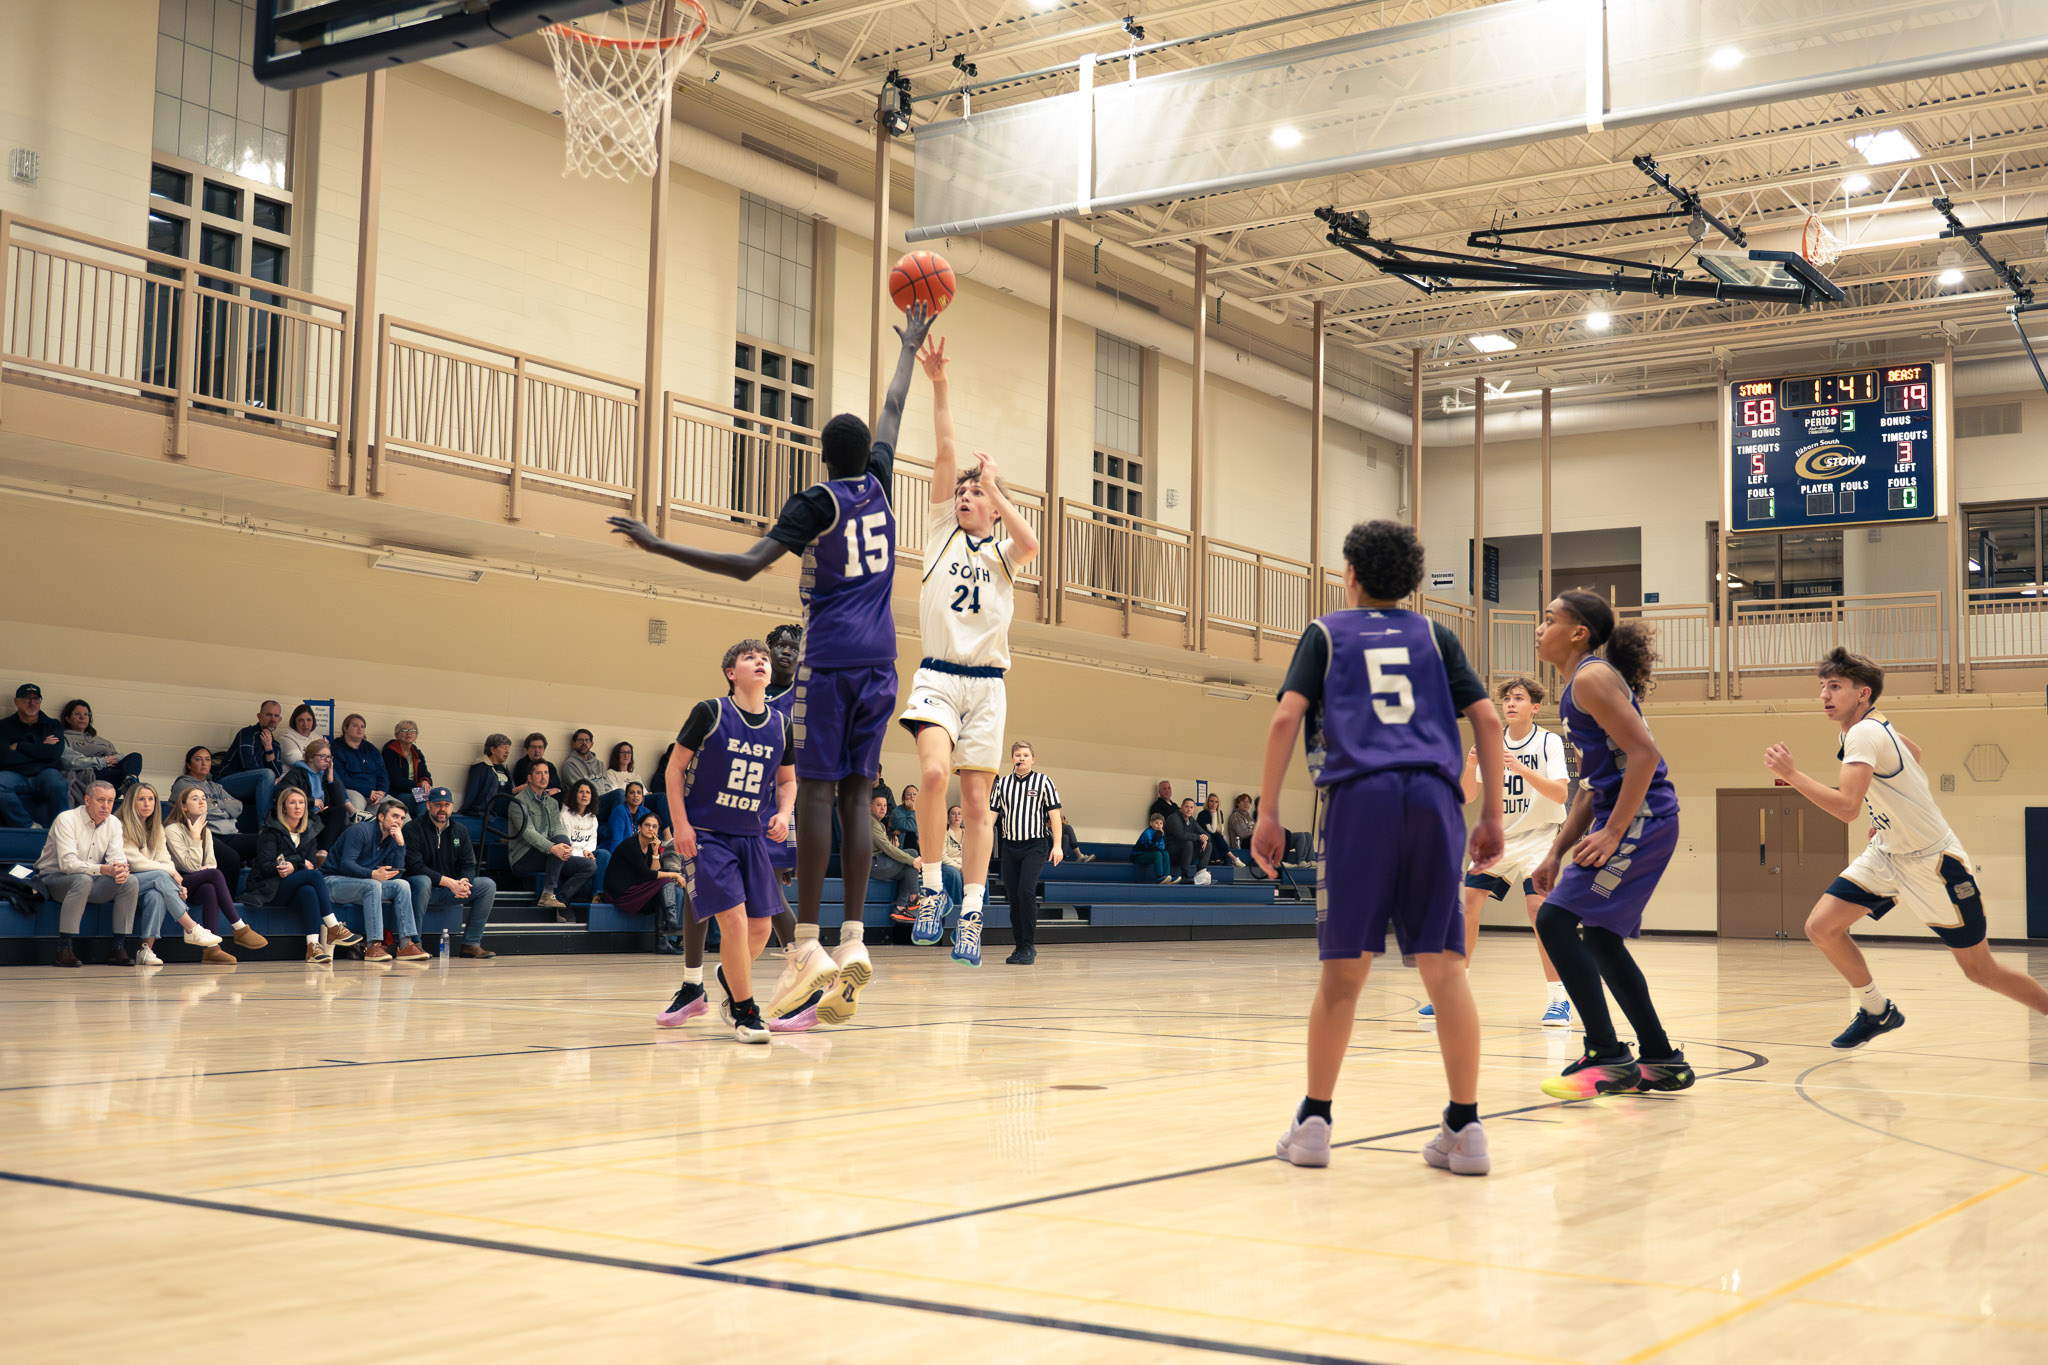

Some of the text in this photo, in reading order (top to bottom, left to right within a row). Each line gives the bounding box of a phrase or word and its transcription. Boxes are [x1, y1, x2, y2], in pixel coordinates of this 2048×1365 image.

[1887, 368, 1921, 382] BEAST
[1739, 382, 1772, 397] STORM
[1814, 374, 1872, 403] 1:41
[1903, 384, 1926, 410] 19
[1743, 399, 1776, 425] 68
[1811, 409, 1830, 417] POSS
[1841, 411, 1855, 431] 3
[1880, 415, 1912, 427] BONUS
[1804, 416, 1837, 428] PERIOD
[1751, 427, 1781, 438] BONUS
[1881, 430, 1928, 443] TIMEOUTS
[1736, 442, 1780, 455] TIMEOUTS
[1795, 438, 1840, 457] Elkhorn South
[1898, 442, 1912, 463] 3
[1752, 453, 1765, 475] 5
[1825, 454, 1867, 467] STORM
[1894, 462, 1917, 473] LEFT
[1747, 474, 1769, 485] LEFT
[1800, 480, 1869, 495] PLAYER FOULS
[1887, 477, 1917, 488] FOULS
[1747, 487, 1775, 499] FOULS
[1903, 487, 1916, 509] 0
[1769, 498, 1775, 518] 1
[843, 510, 890, 578] 15
[948, 562, 991, 583] SOTH
[950, 584, 981, 614] 24
[1363, 646, 1416, 725] 5
[727, 737, 775, 760] EAST
[727, 757, 765, 795] 22
[715, 791, 762, 812] HIGH
